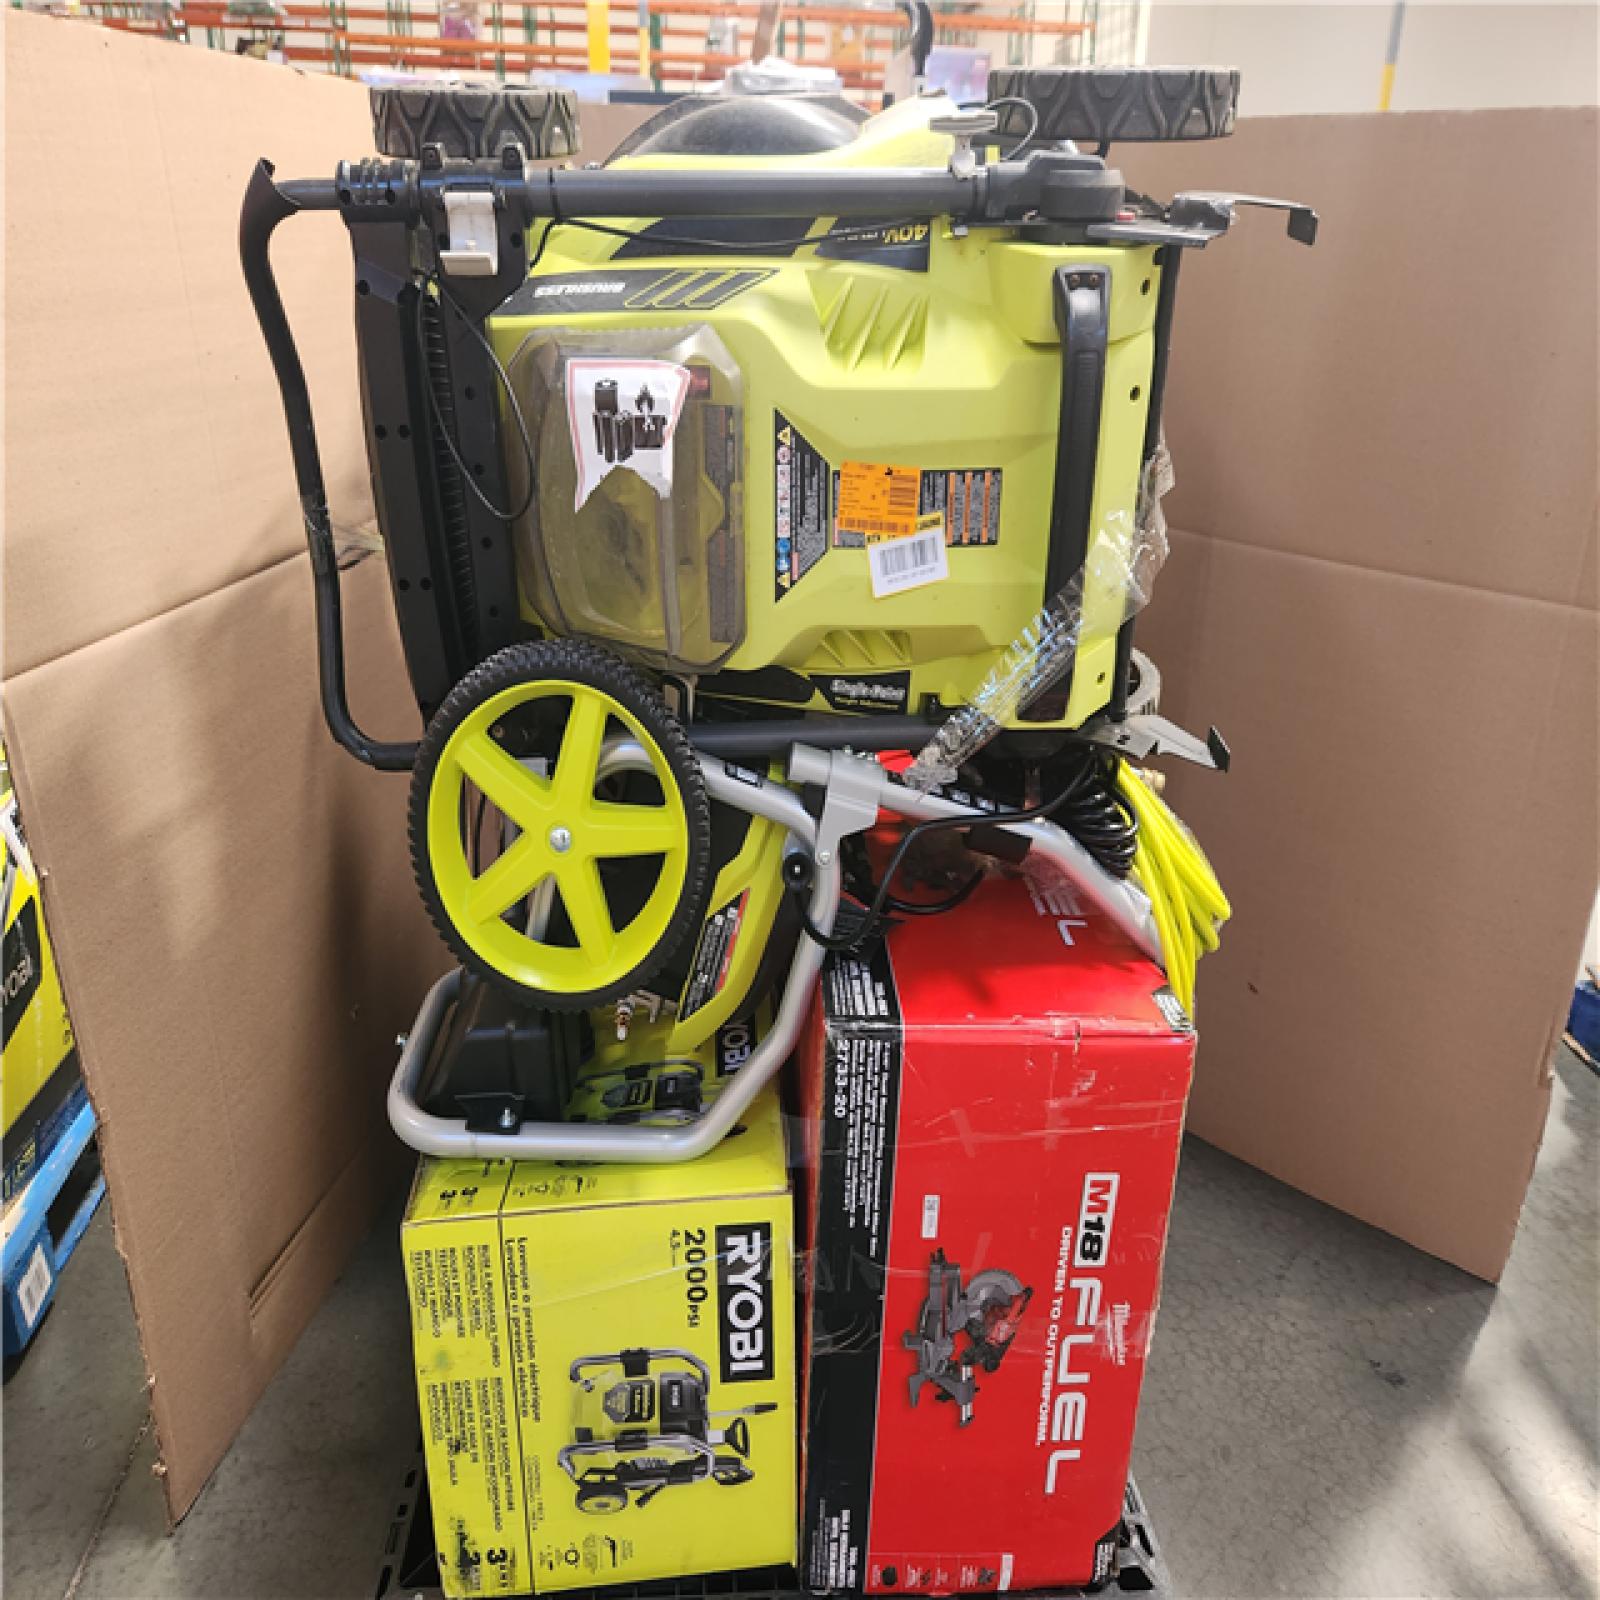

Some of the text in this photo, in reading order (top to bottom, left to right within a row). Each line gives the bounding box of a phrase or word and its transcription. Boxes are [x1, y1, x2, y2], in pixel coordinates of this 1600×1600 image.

[725, 1230, 765, 1372] RYOBI
[1050, 1298, 1063, 1320] TO
[1055, 1226, 1072, 1293] DRIVEN
[1046, 1179, 1112, 1494] M18 FUEL
